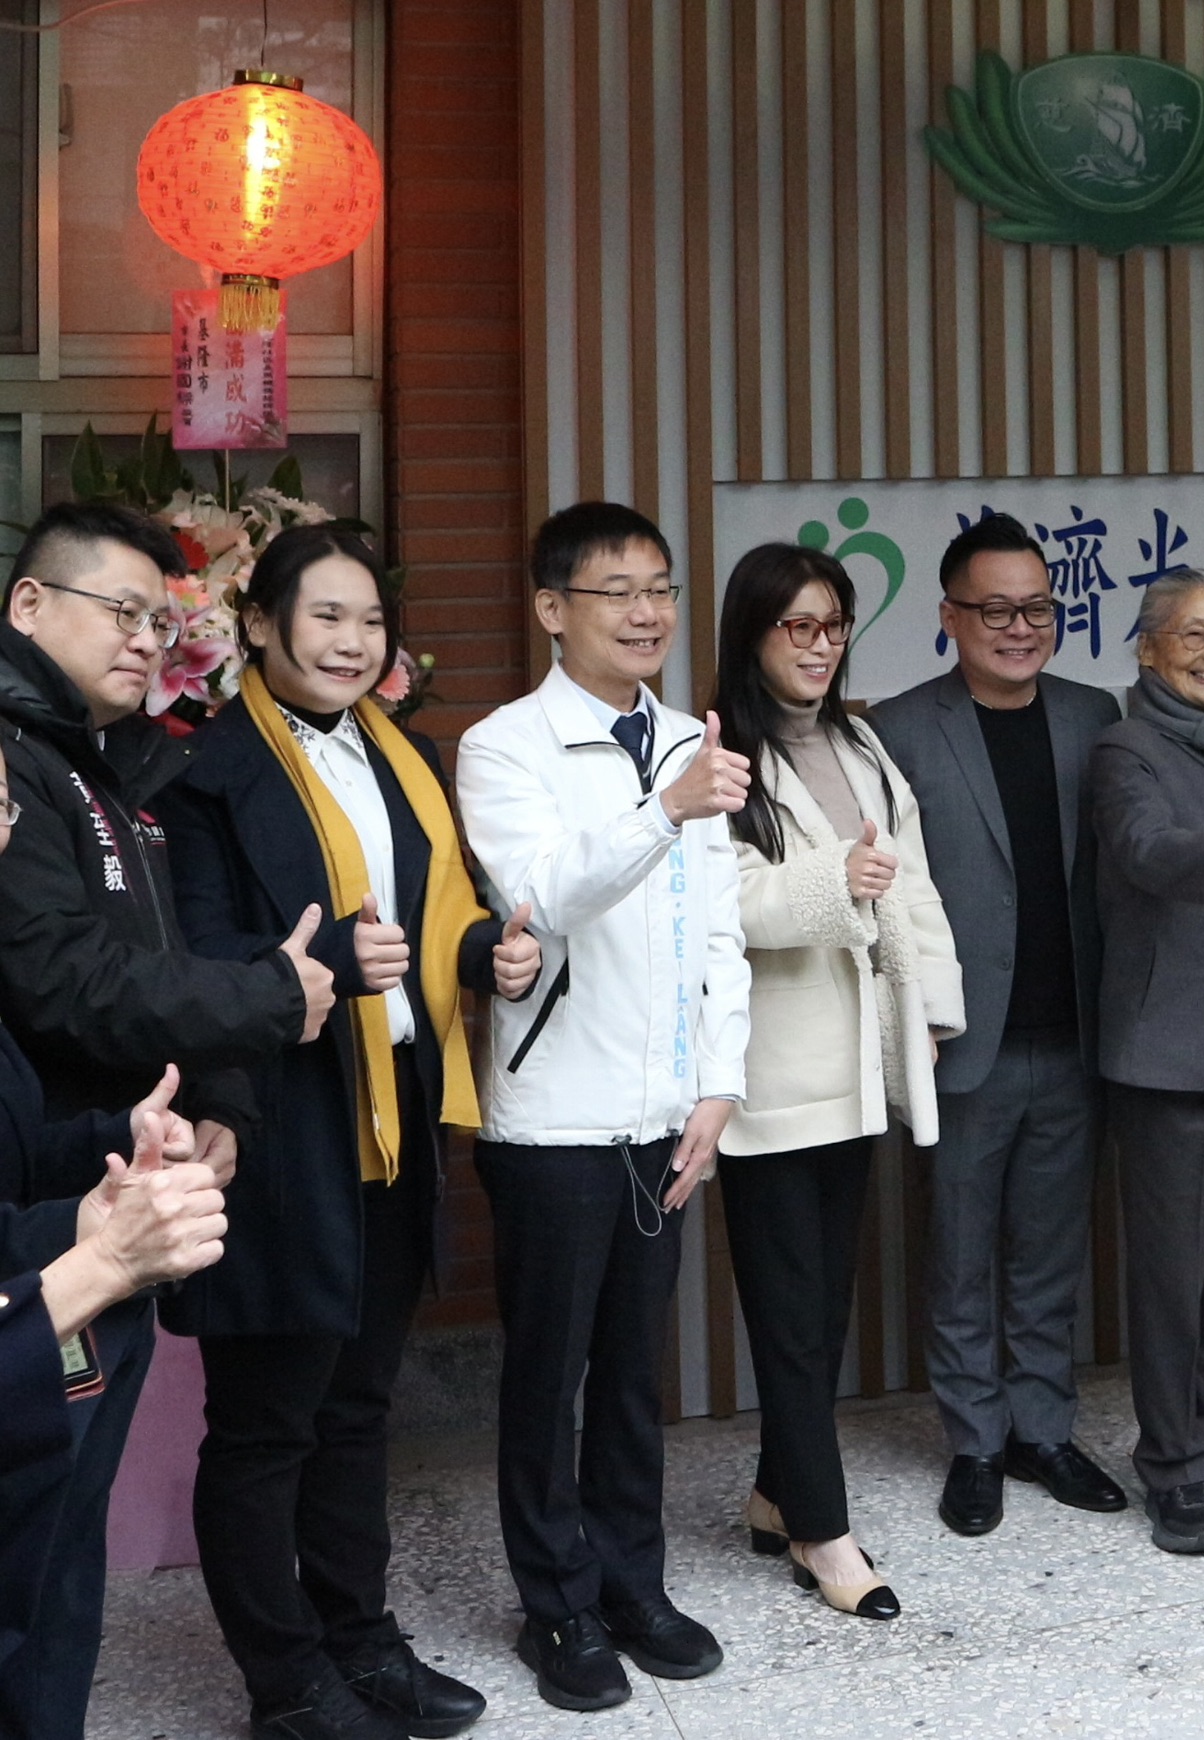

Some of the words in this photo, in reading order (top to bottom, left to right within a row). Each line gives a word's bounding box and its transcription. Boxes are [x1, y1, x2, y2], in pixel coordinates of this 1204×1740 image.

[197, 317, 211, 394] 基隆市
[225, 328, 247, 434] 滿成功
